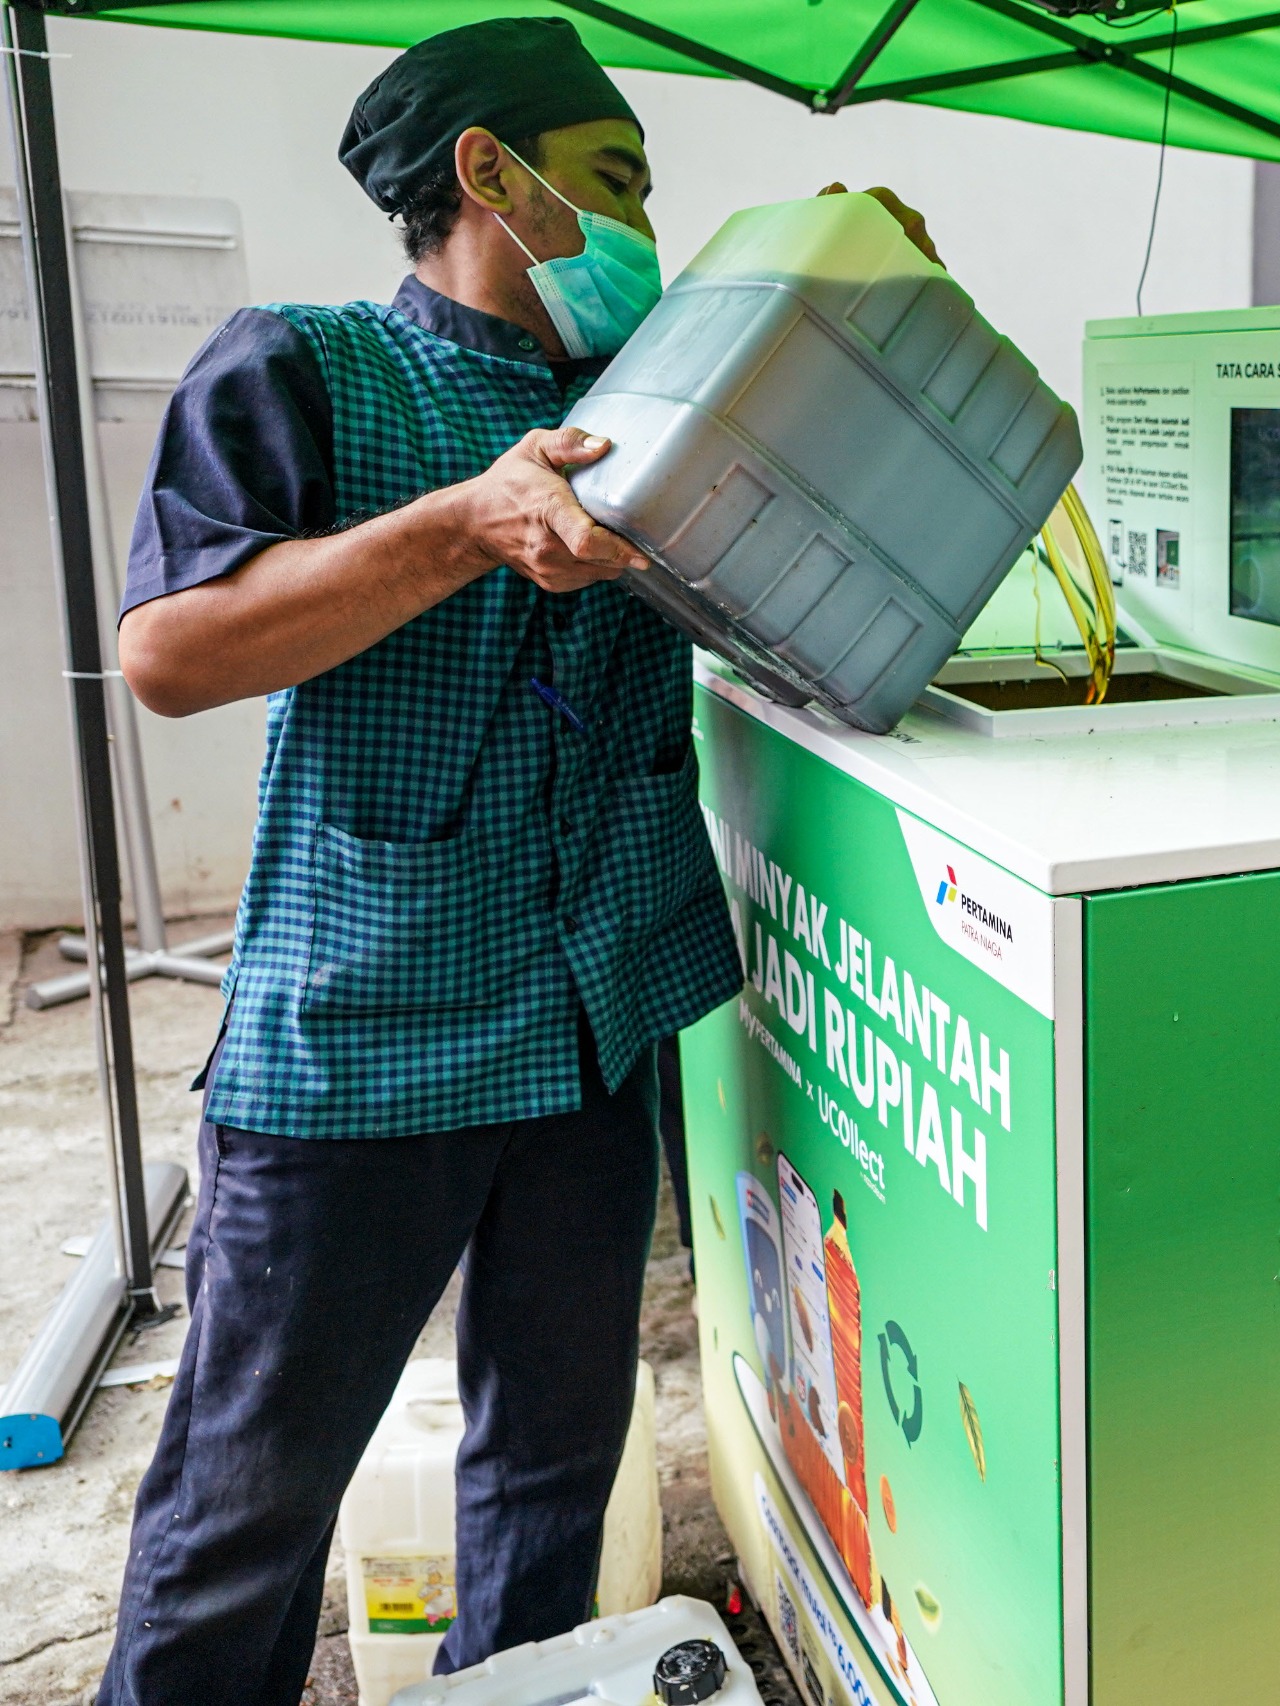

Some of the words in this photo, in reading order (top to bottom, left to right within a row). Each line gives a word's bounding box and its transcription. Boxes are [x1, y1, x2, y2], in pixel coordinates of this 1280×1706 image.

[1216, 363, 1243, 379] TATA
[1244, 362, 1275, 379] CARA
[961, 893, 1013, 943] PERTAMINA
[961, 920, 980, 945] PATRA
[980, 934, 1003, 961] NIAGA
[698, 799, 732, 878] NI
[735, 831, 831, 971] MINYAK
[835, 918, 1011, 1132] JELANTAH
[752, 921, 817, 1053] JADI
[823, 986, 988, 1233] RUPIAH
[818, 1085, 886, 1190] UCOllect
